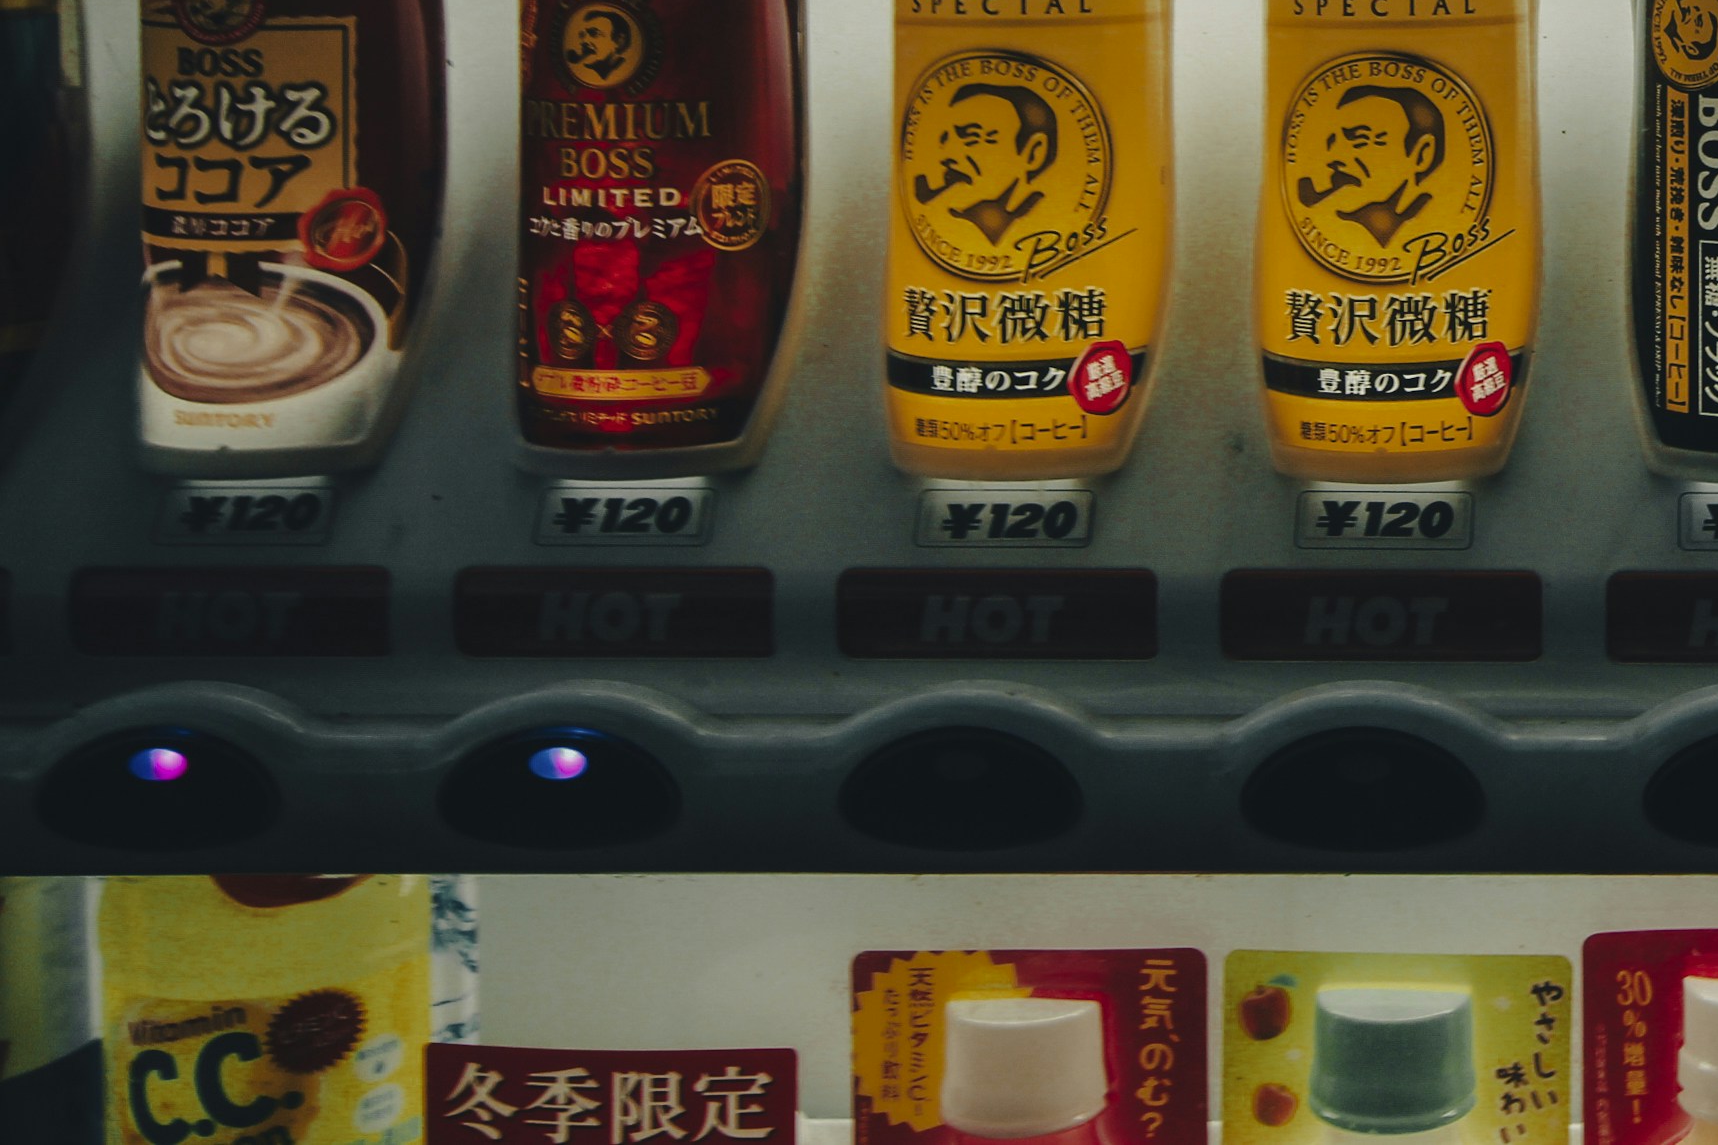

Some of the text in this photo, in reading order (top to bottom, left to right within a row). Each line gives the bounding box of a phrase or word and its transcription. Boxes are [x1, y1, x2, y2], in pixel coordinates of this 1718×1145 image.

[177, 47, 263, 77] BOSS
[934, 60, 974, 85] THE
[979, 60, 1040, 83] BOSS
[1042, 76, 1073, 100] OF
[525, 101, 712, 141] PREMIUM
[1320, 61, 1485, 167] THE BOSS OF THEM
[155, 153, 312, 207] ココア
[560, 148, 654, 180] BOSS
[543, 186, 682, 209] LIMITED
[967, 254, 1013, 272] 1992
[1354, 255, 1402, 273] 1992
[904, 286, 1108, 344] 贅沢微糖
[1285, 288, 1490, 346] 贅沢微糖
[930, 366, 1067, 393] 豊醇のコク
[1317, 368, 1453, 395] 豊醇のコク
[180, 494, 320, 532] ¥120
[554, 496, 692, 533] ¥120
[942, 501, 1078, 540] ¥120
[1316, 500, 1455, 539] ¥120
[540, 592, 684, 642] HOT
[920, 595, 1066, 644] HOT
[1304, 597, 1449, 646] HOT
[1531, 980, 1564, 1109] やさしい
[443, 1061, 776, 1145] 冬季限定
[1496, 1061, 1529, 1144] 味わい
